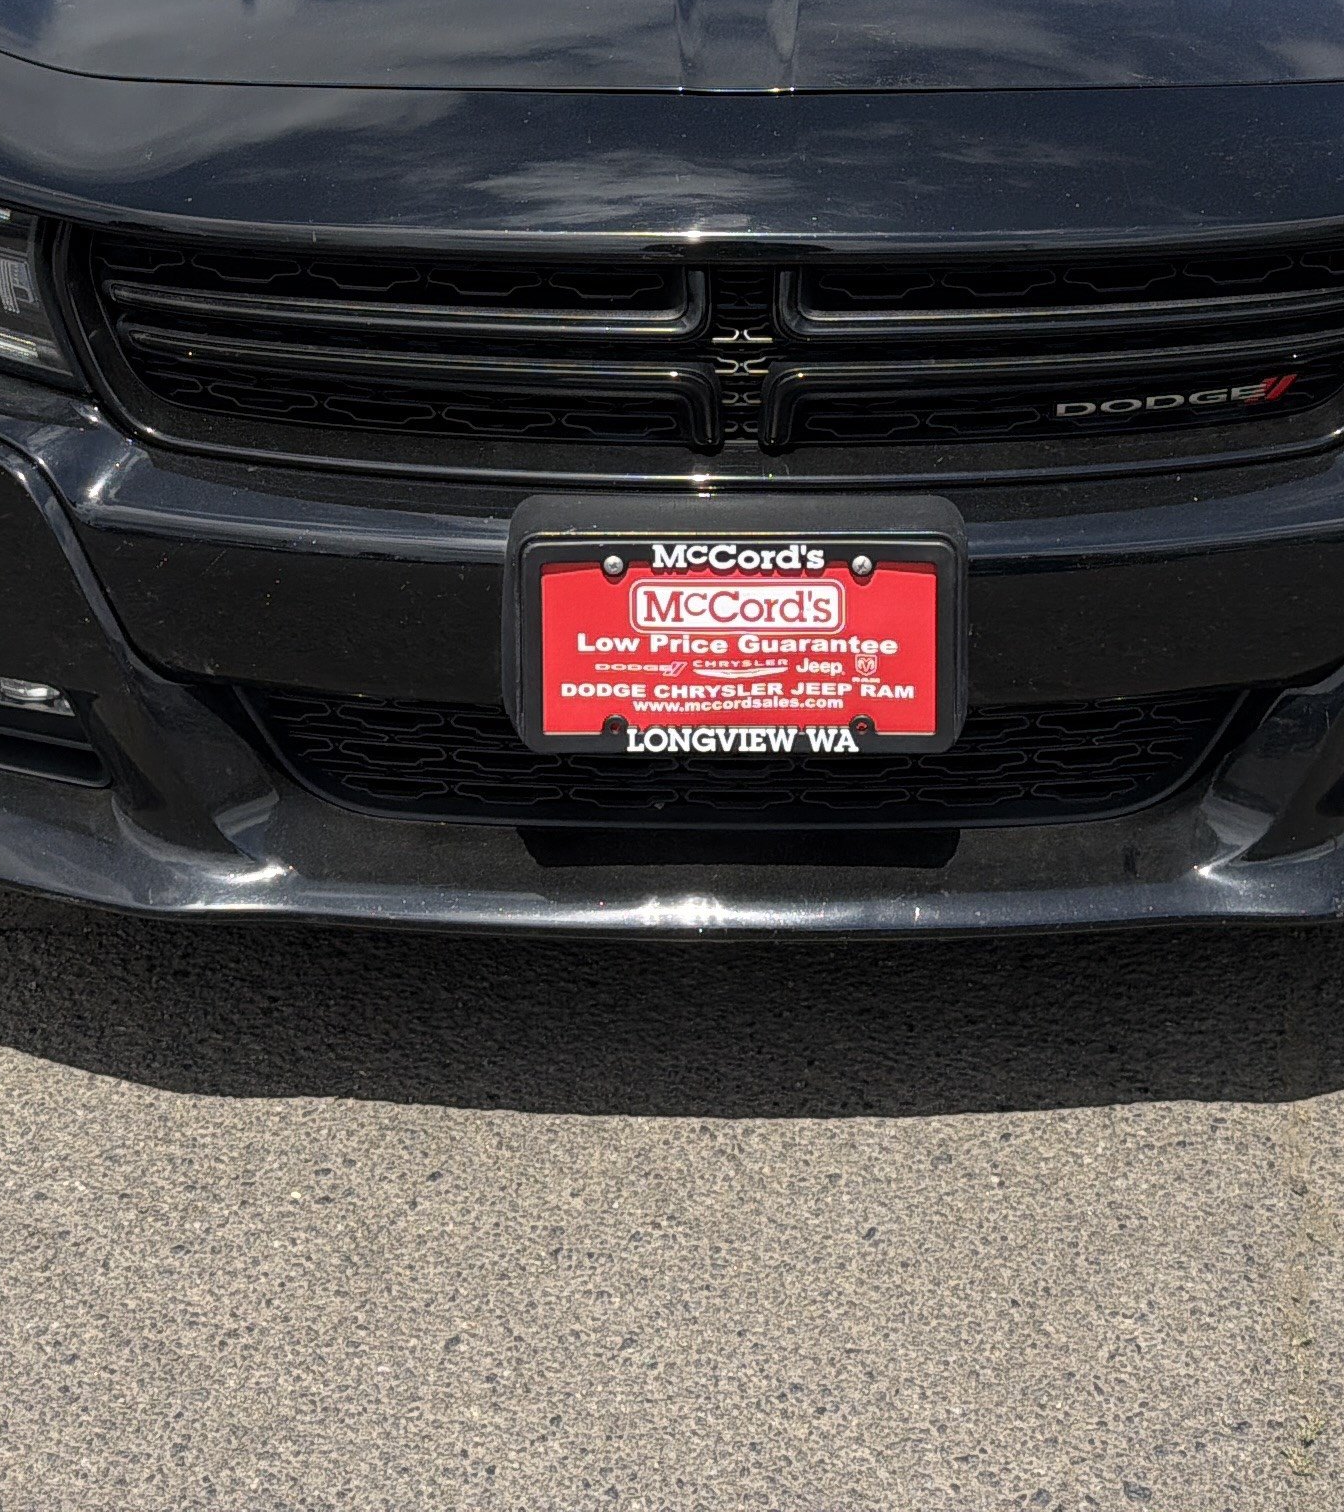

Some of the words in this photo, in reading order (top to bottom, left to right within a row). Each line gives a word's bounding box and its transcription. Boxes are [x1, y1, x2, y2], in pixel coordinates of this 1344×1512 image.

[1056, 383, 1267, 417] DODGE
[652, 544, 824, 570] McCord's
[643, 590, 832, 623] McCord's
[576, 633, 639, 654] Low
[650, 633, 729, 654] Price
[737, 634, 899, 655] Guarantee
[692, 658, 789, 669] CHRYSLER
[795, 657, 844, 677] Jeep
[561, 683, 647, 699] DODGE
[653, 682, 783, 699] CHRYSLER
[790, 681, 852, 697] JEEP
[860, 684, 915, 699] RAM
[632, 696, 844, 712] www.mccordsales.com
[626, 727, 798, 753] LONGVIEW
[805, 727, 859, 753] WA
